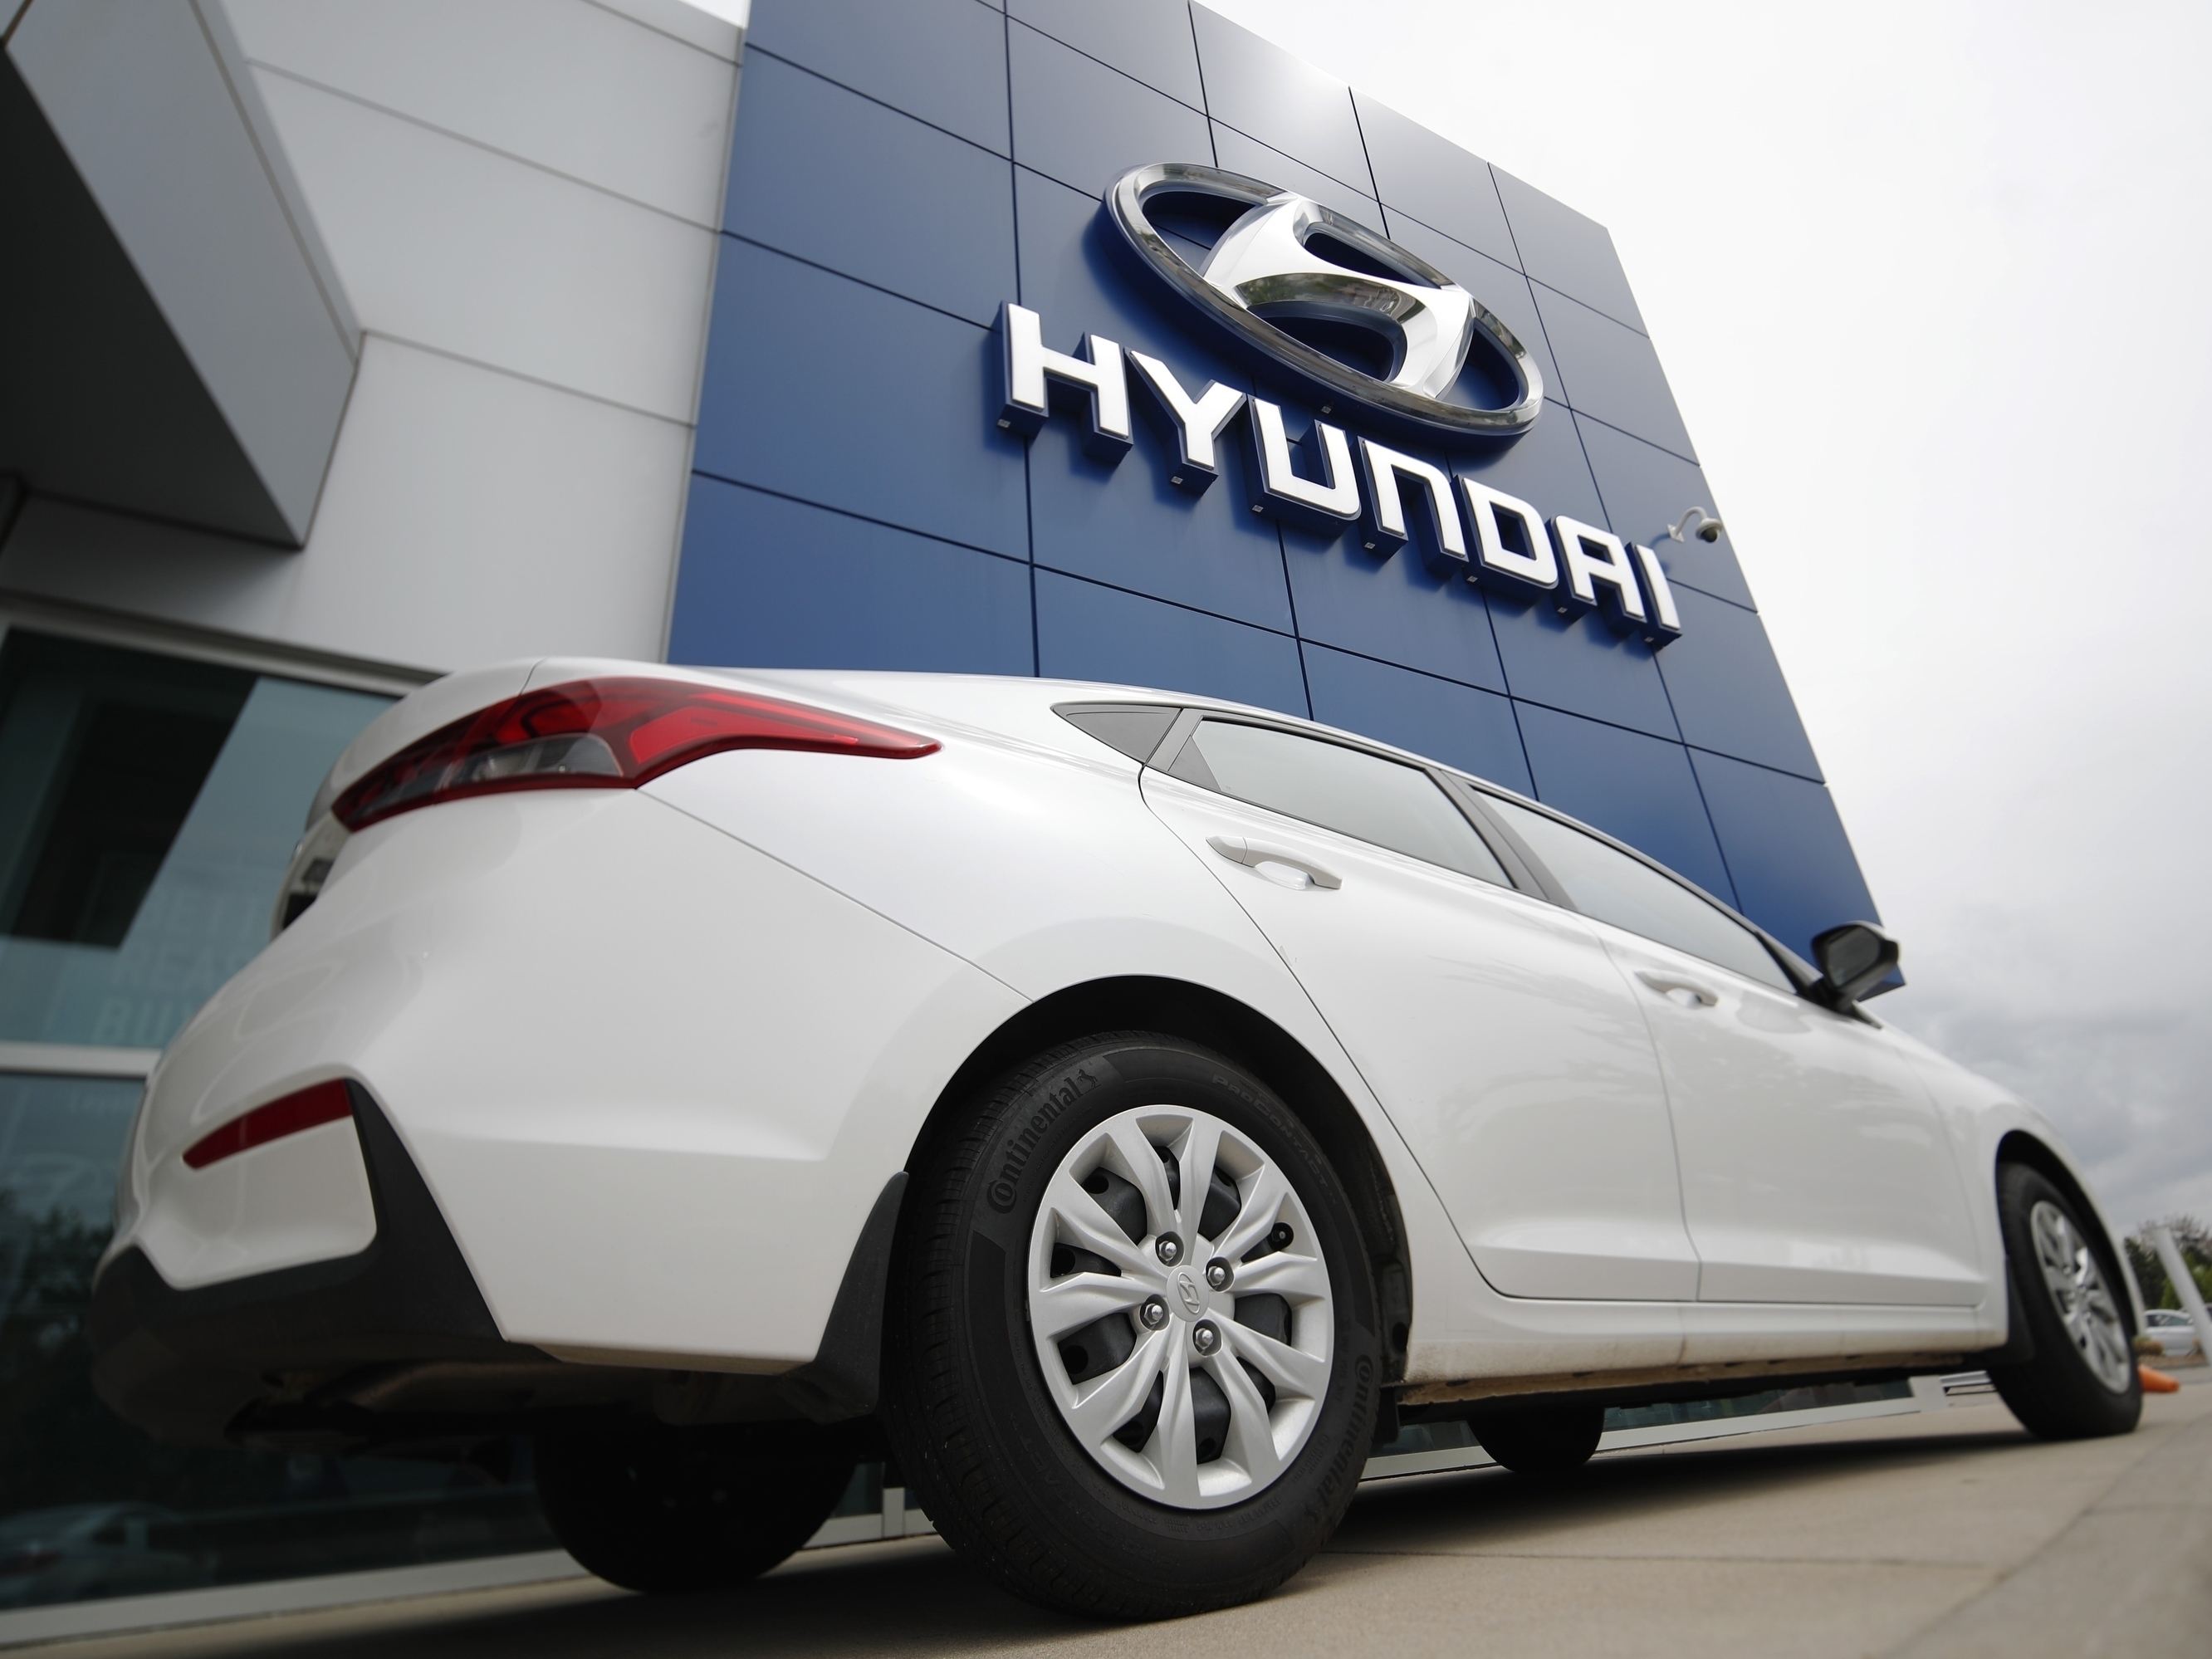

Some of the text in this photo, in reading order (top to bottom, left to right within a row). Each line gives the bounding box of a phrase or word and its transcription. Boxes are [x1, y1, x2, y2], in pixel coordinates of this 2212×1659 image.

[1005, 301, 1682, 634] HYUNDAI
[986, 1077, 1084, 1214] Continental
[1314, 1353, 1373, 1508] Continental
